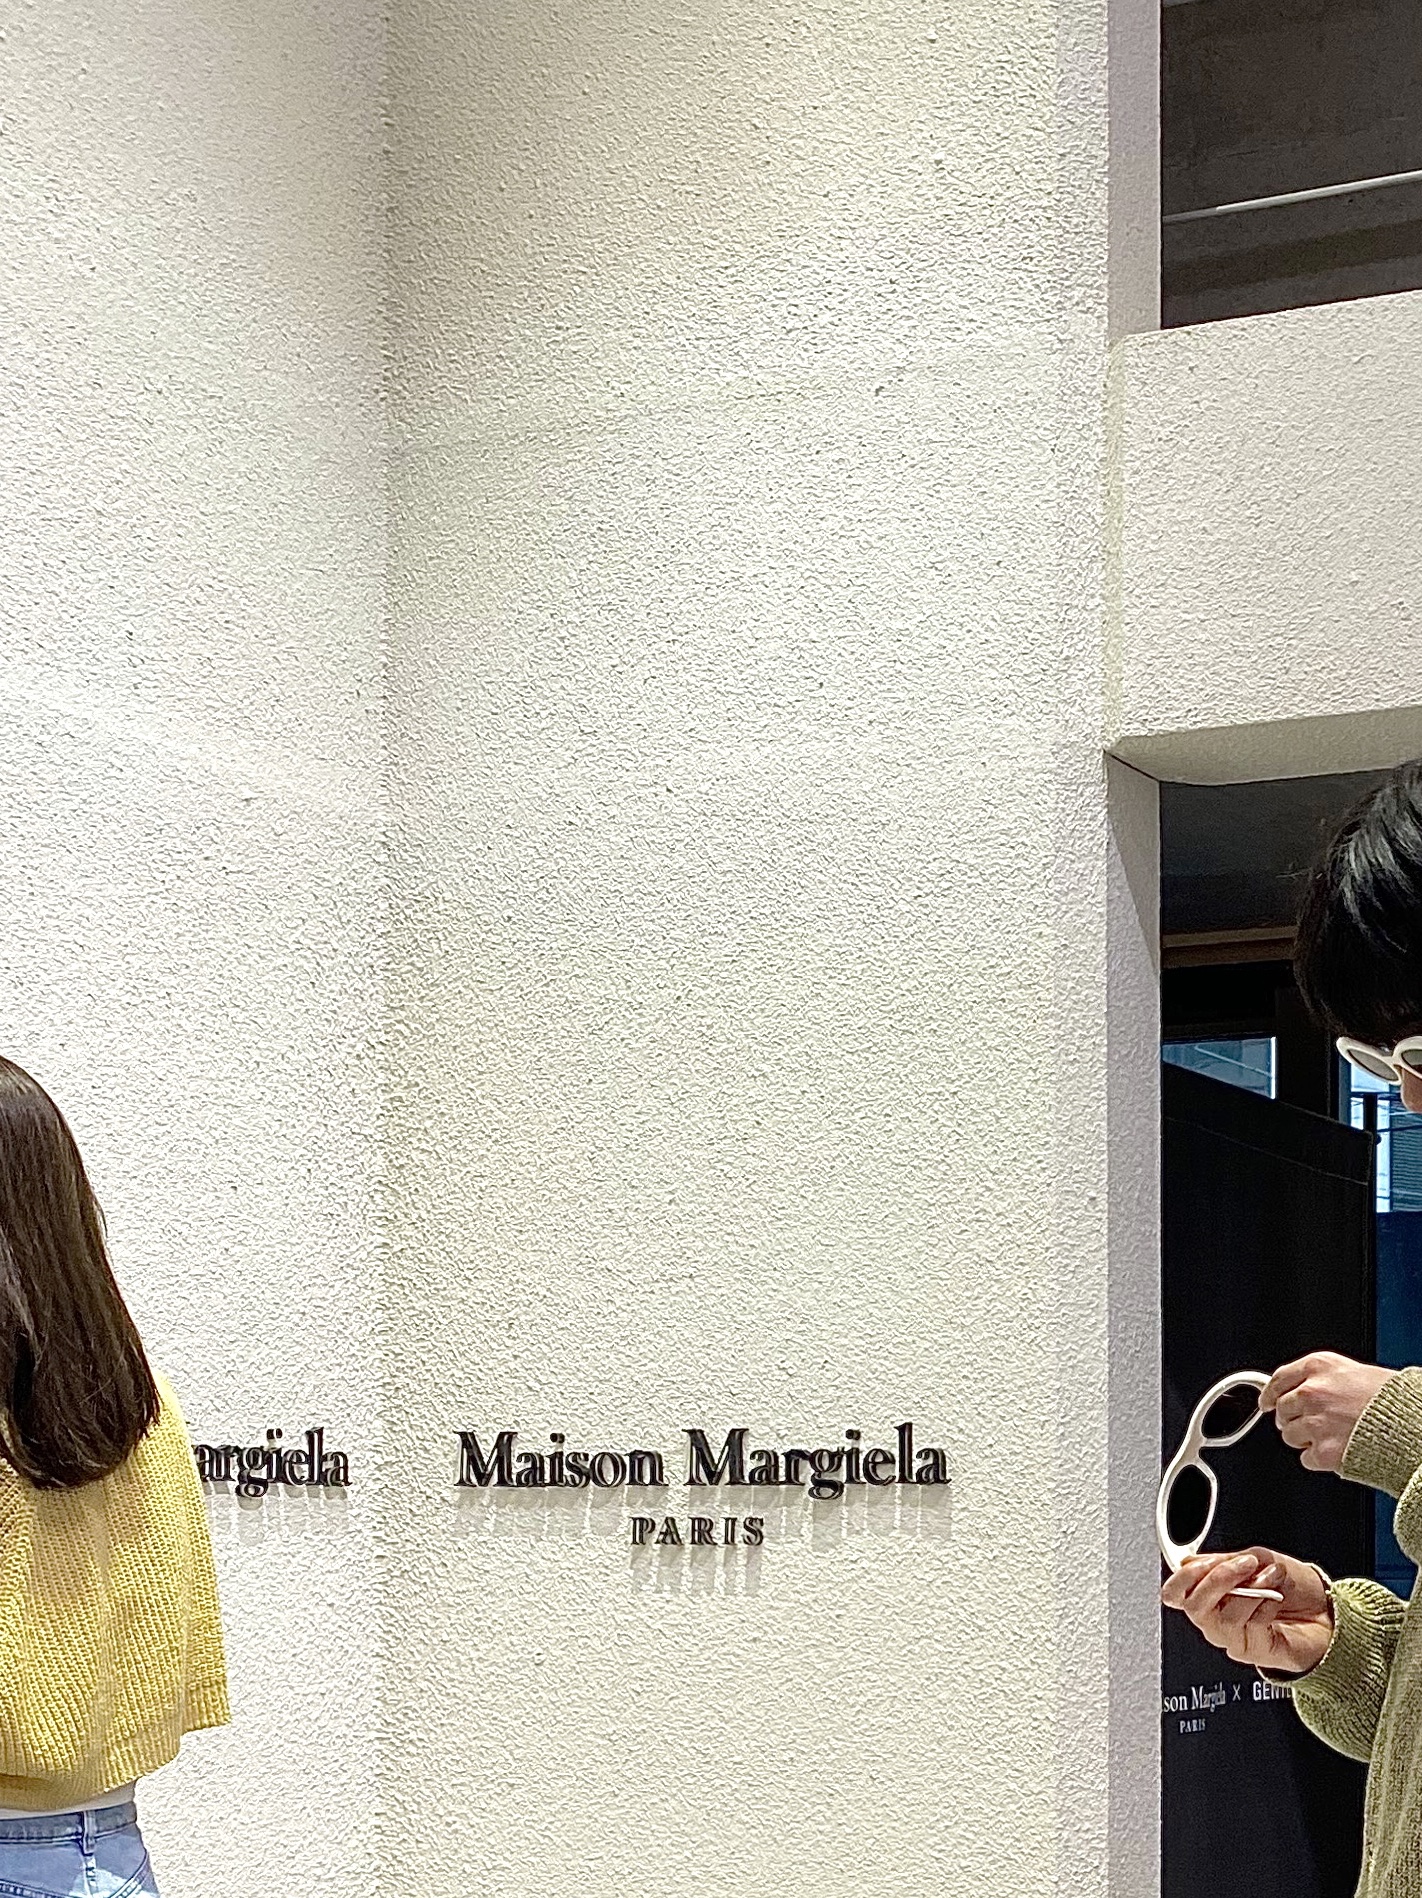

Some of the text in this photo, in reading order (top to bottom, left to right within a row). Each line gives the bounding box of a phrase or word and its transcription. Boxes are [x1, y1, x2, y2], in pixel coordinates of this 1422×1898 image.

[453, 1422, 951, 1500] Maison Margiela
[629, 1516, 765, 1546] PARIS
[1180, 1718, 1206, 1734] PARIS
